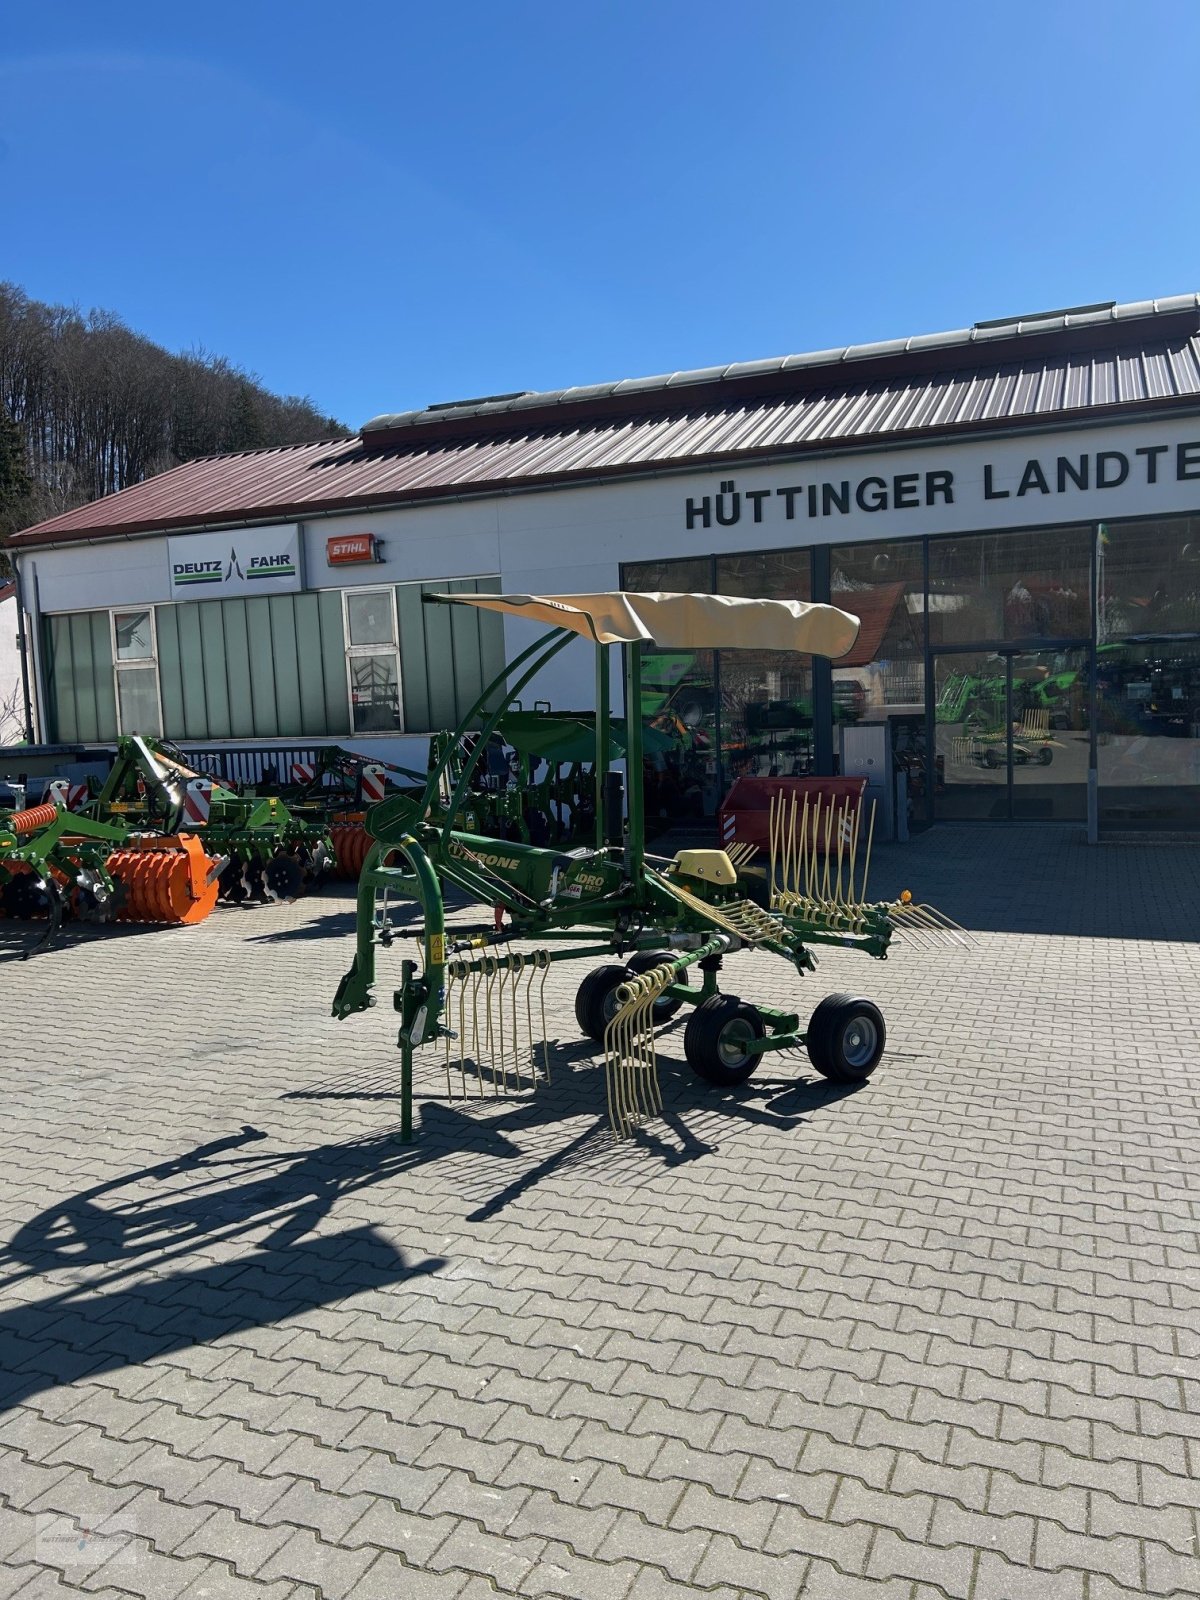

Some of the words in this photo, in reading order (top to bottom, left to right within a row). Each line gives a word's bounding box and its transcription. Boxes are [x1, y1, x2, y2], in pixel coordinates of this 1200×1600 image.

[685, 470, 954, 529] HÜTTINGER
[332, 543, 366, 555] STIHL
[173, 560, 222, 574] DEUTZ
[250, 554, 291, 568] FAHR
